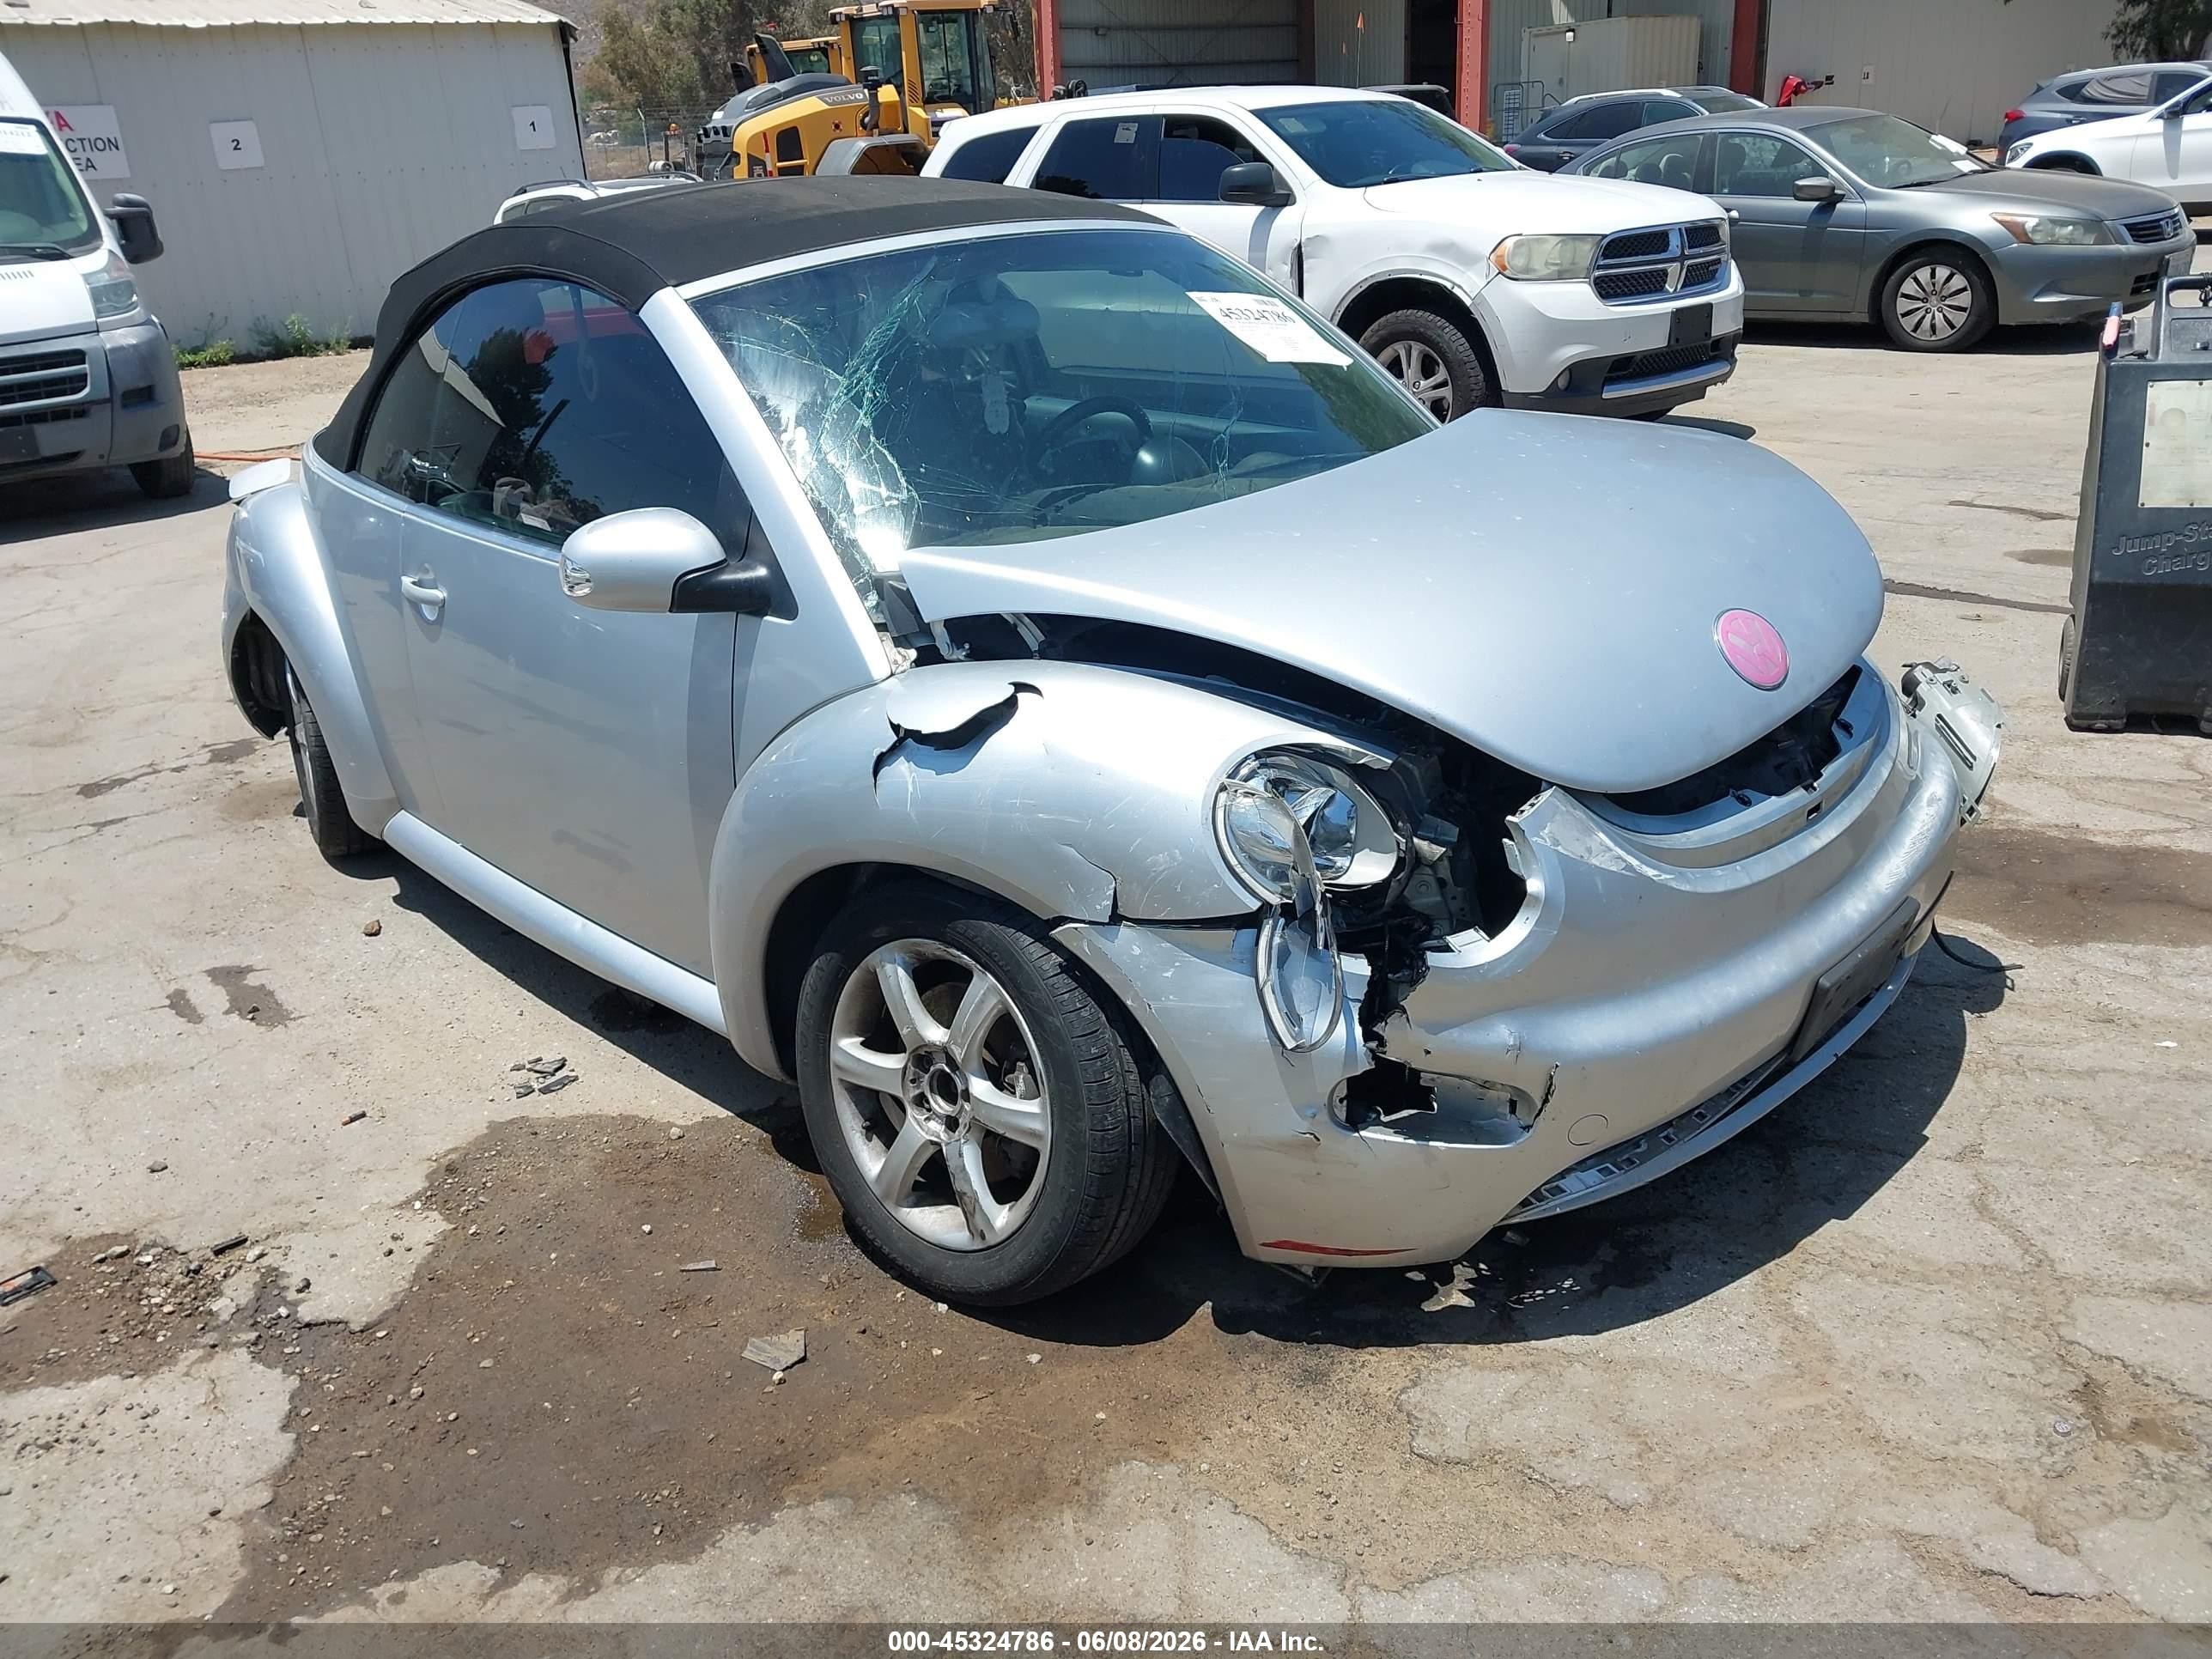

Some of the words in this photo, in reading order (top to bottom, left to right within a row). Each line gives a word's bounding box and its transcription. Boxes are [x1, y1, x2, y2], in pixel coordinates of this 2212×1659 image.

[823, 93, 864, 103] VOLVO
[529, 121, 537, 132] 1
[230, 137, 242, 151] 2
[1219, 307, 1297, 324] 45324786
[2112, 520, 2212, 556] Jump-St
[2142, 550, 2212, 576] Charg
